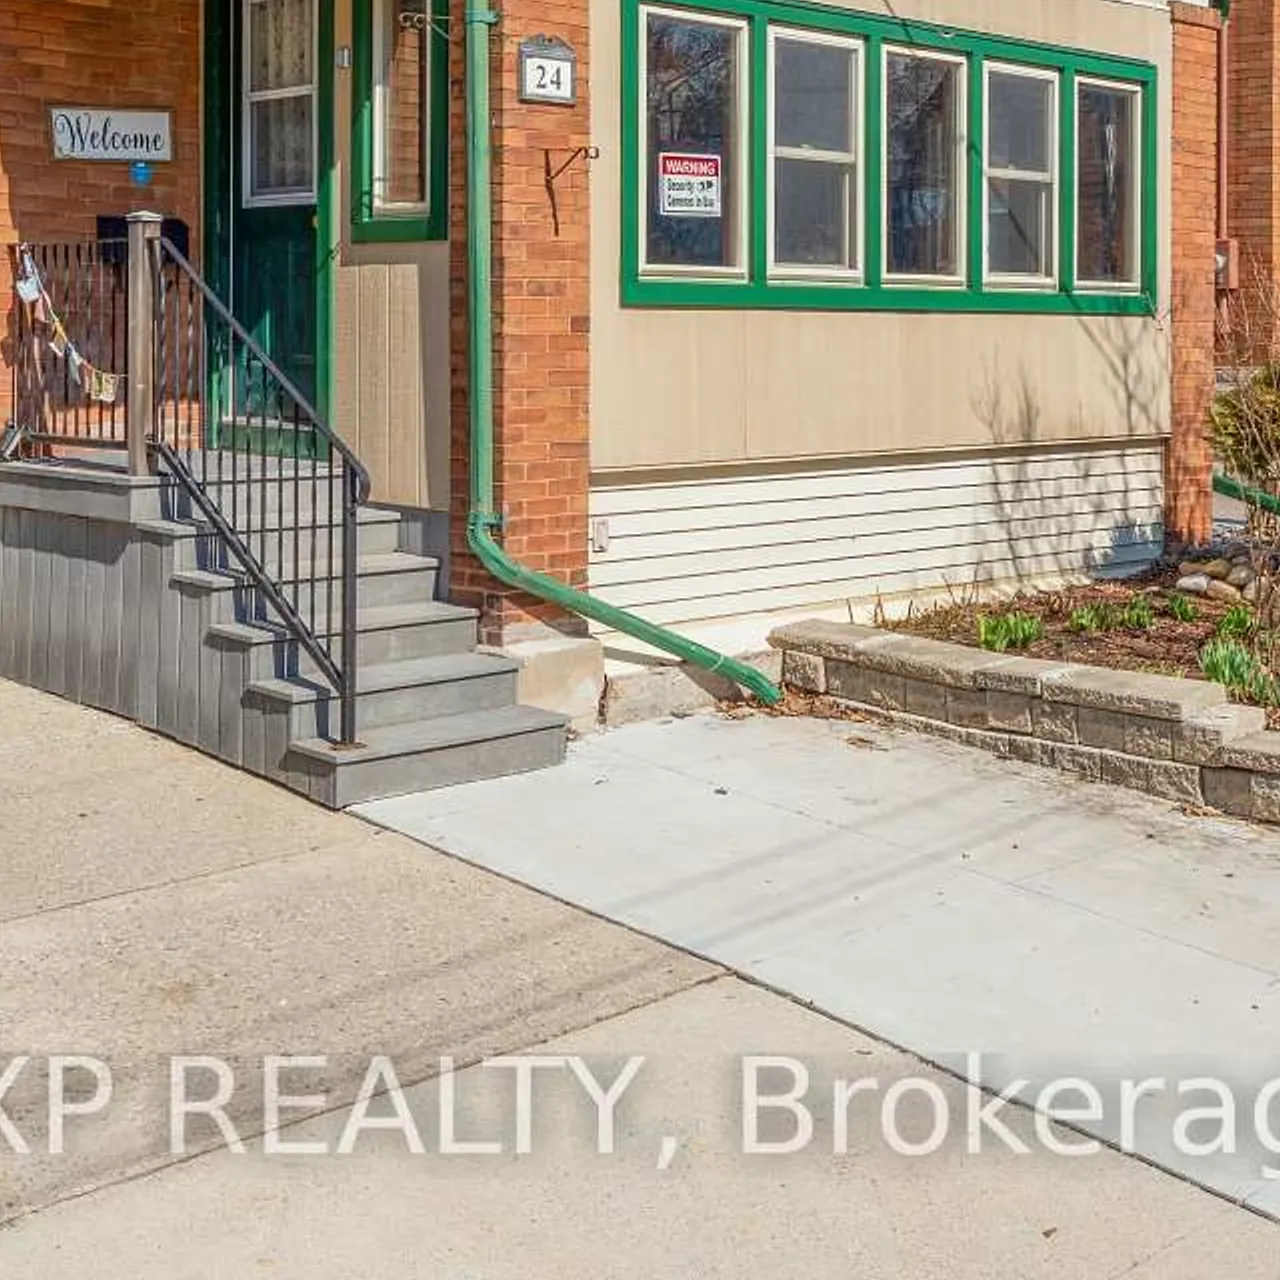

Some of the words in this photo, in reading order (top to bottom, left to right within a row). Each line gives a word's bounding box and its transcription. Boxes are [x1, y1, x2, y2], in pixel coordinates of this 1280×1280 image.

[536, 64, 561, 90] 24
[55, 112, 164, 153] Welcome
[665, 160, 716, 175] WARNING
